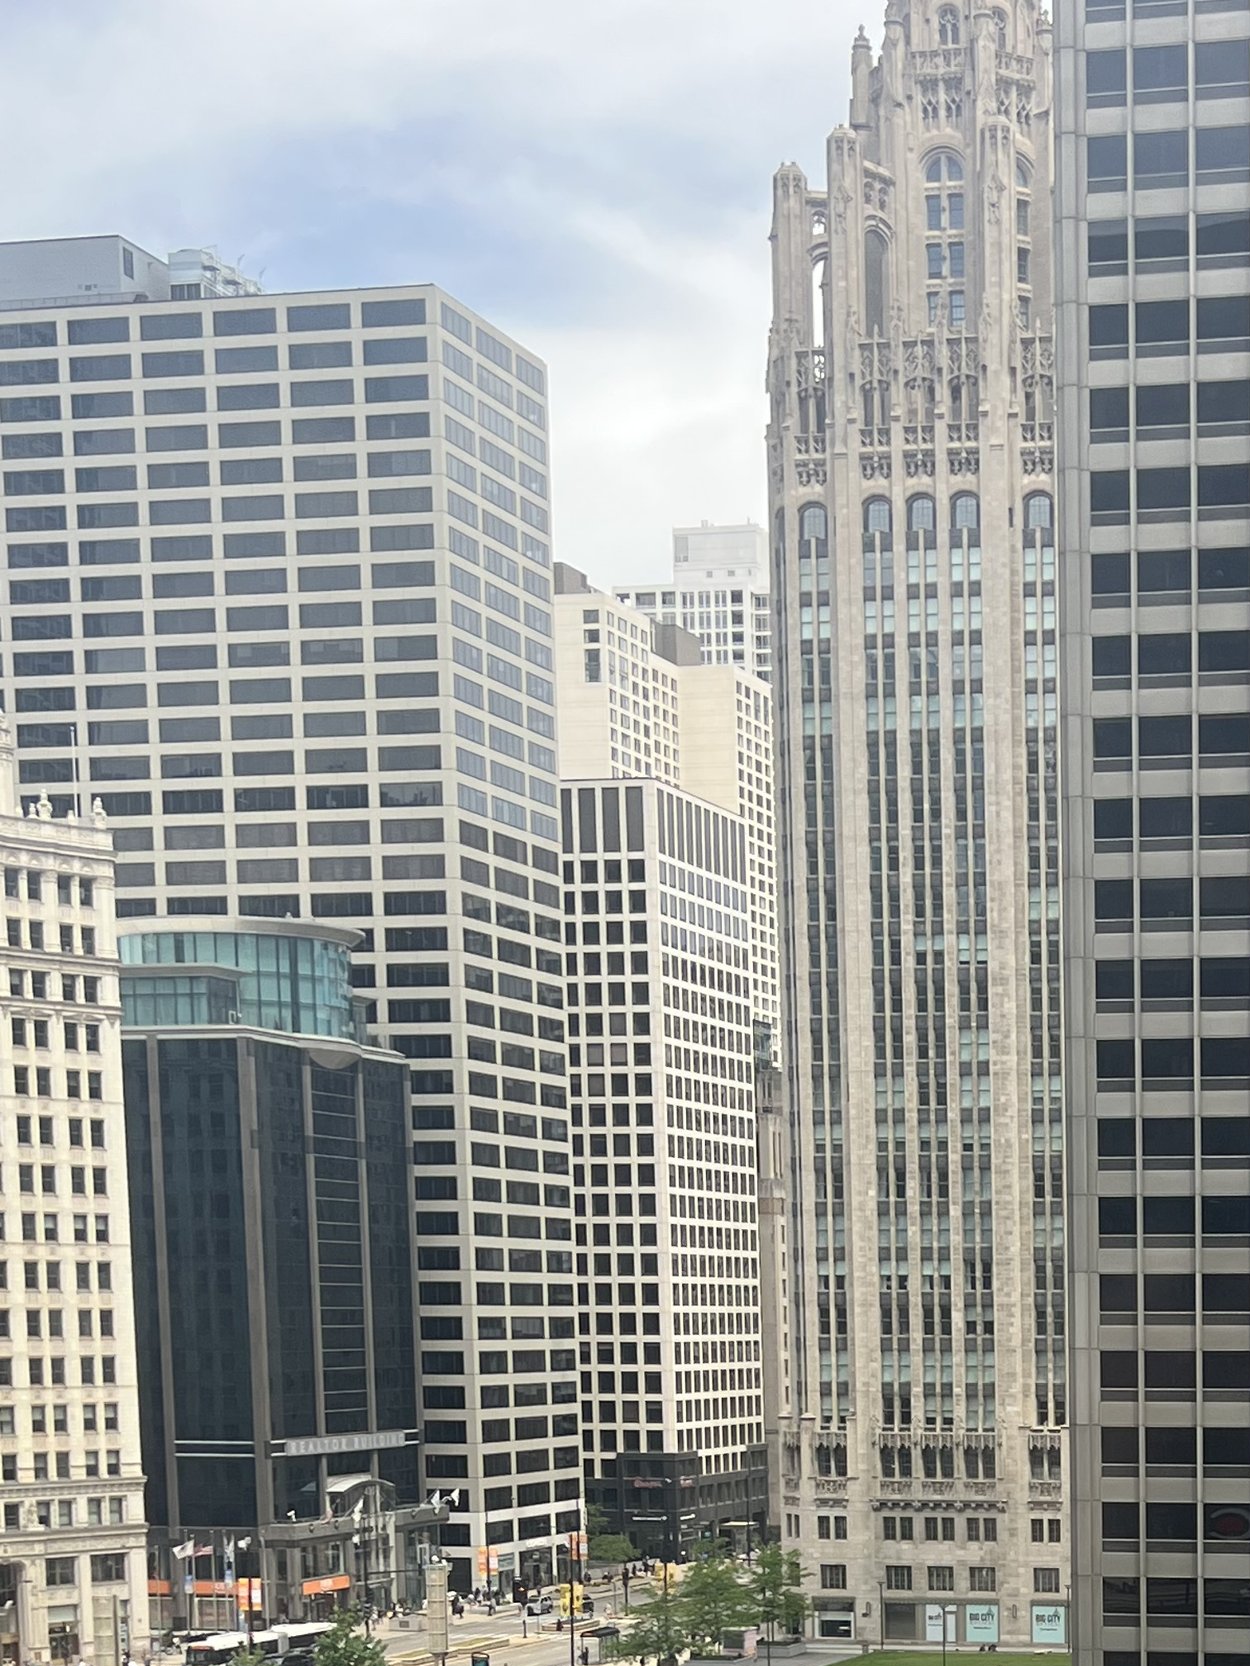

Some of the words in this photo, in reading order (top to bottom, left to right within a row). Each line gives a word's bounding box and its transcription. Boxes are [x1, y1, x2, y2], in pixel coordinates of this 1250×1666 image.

[353, 1432, 405, 1449] BUILDING
[969, 1613, 980, 1621] BIG
[981, 1612, 995, 1622] CITY
[1047, 1613, 1061, 1623] CITY
